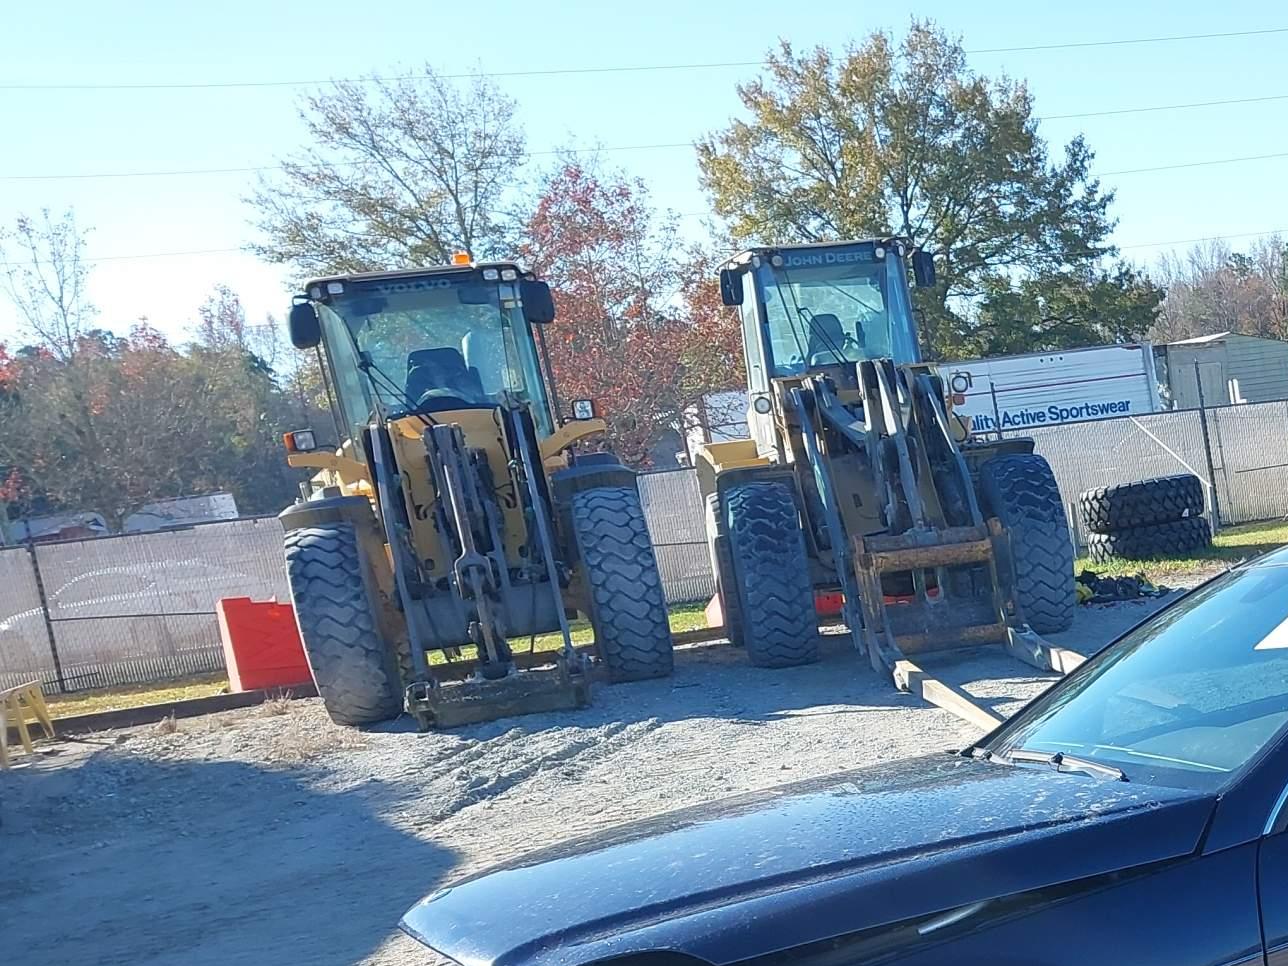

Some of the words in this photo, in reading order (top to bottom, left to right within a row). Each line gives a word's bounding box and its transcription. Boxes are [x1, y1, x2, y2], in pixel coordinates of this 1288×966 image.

[784, 255, 822, 267] JOHN
[825, 251, 873, 264] DEERE
[1001, 408, 1047, 428] Active
[1047, 399, 1131, 422] Sportswear
